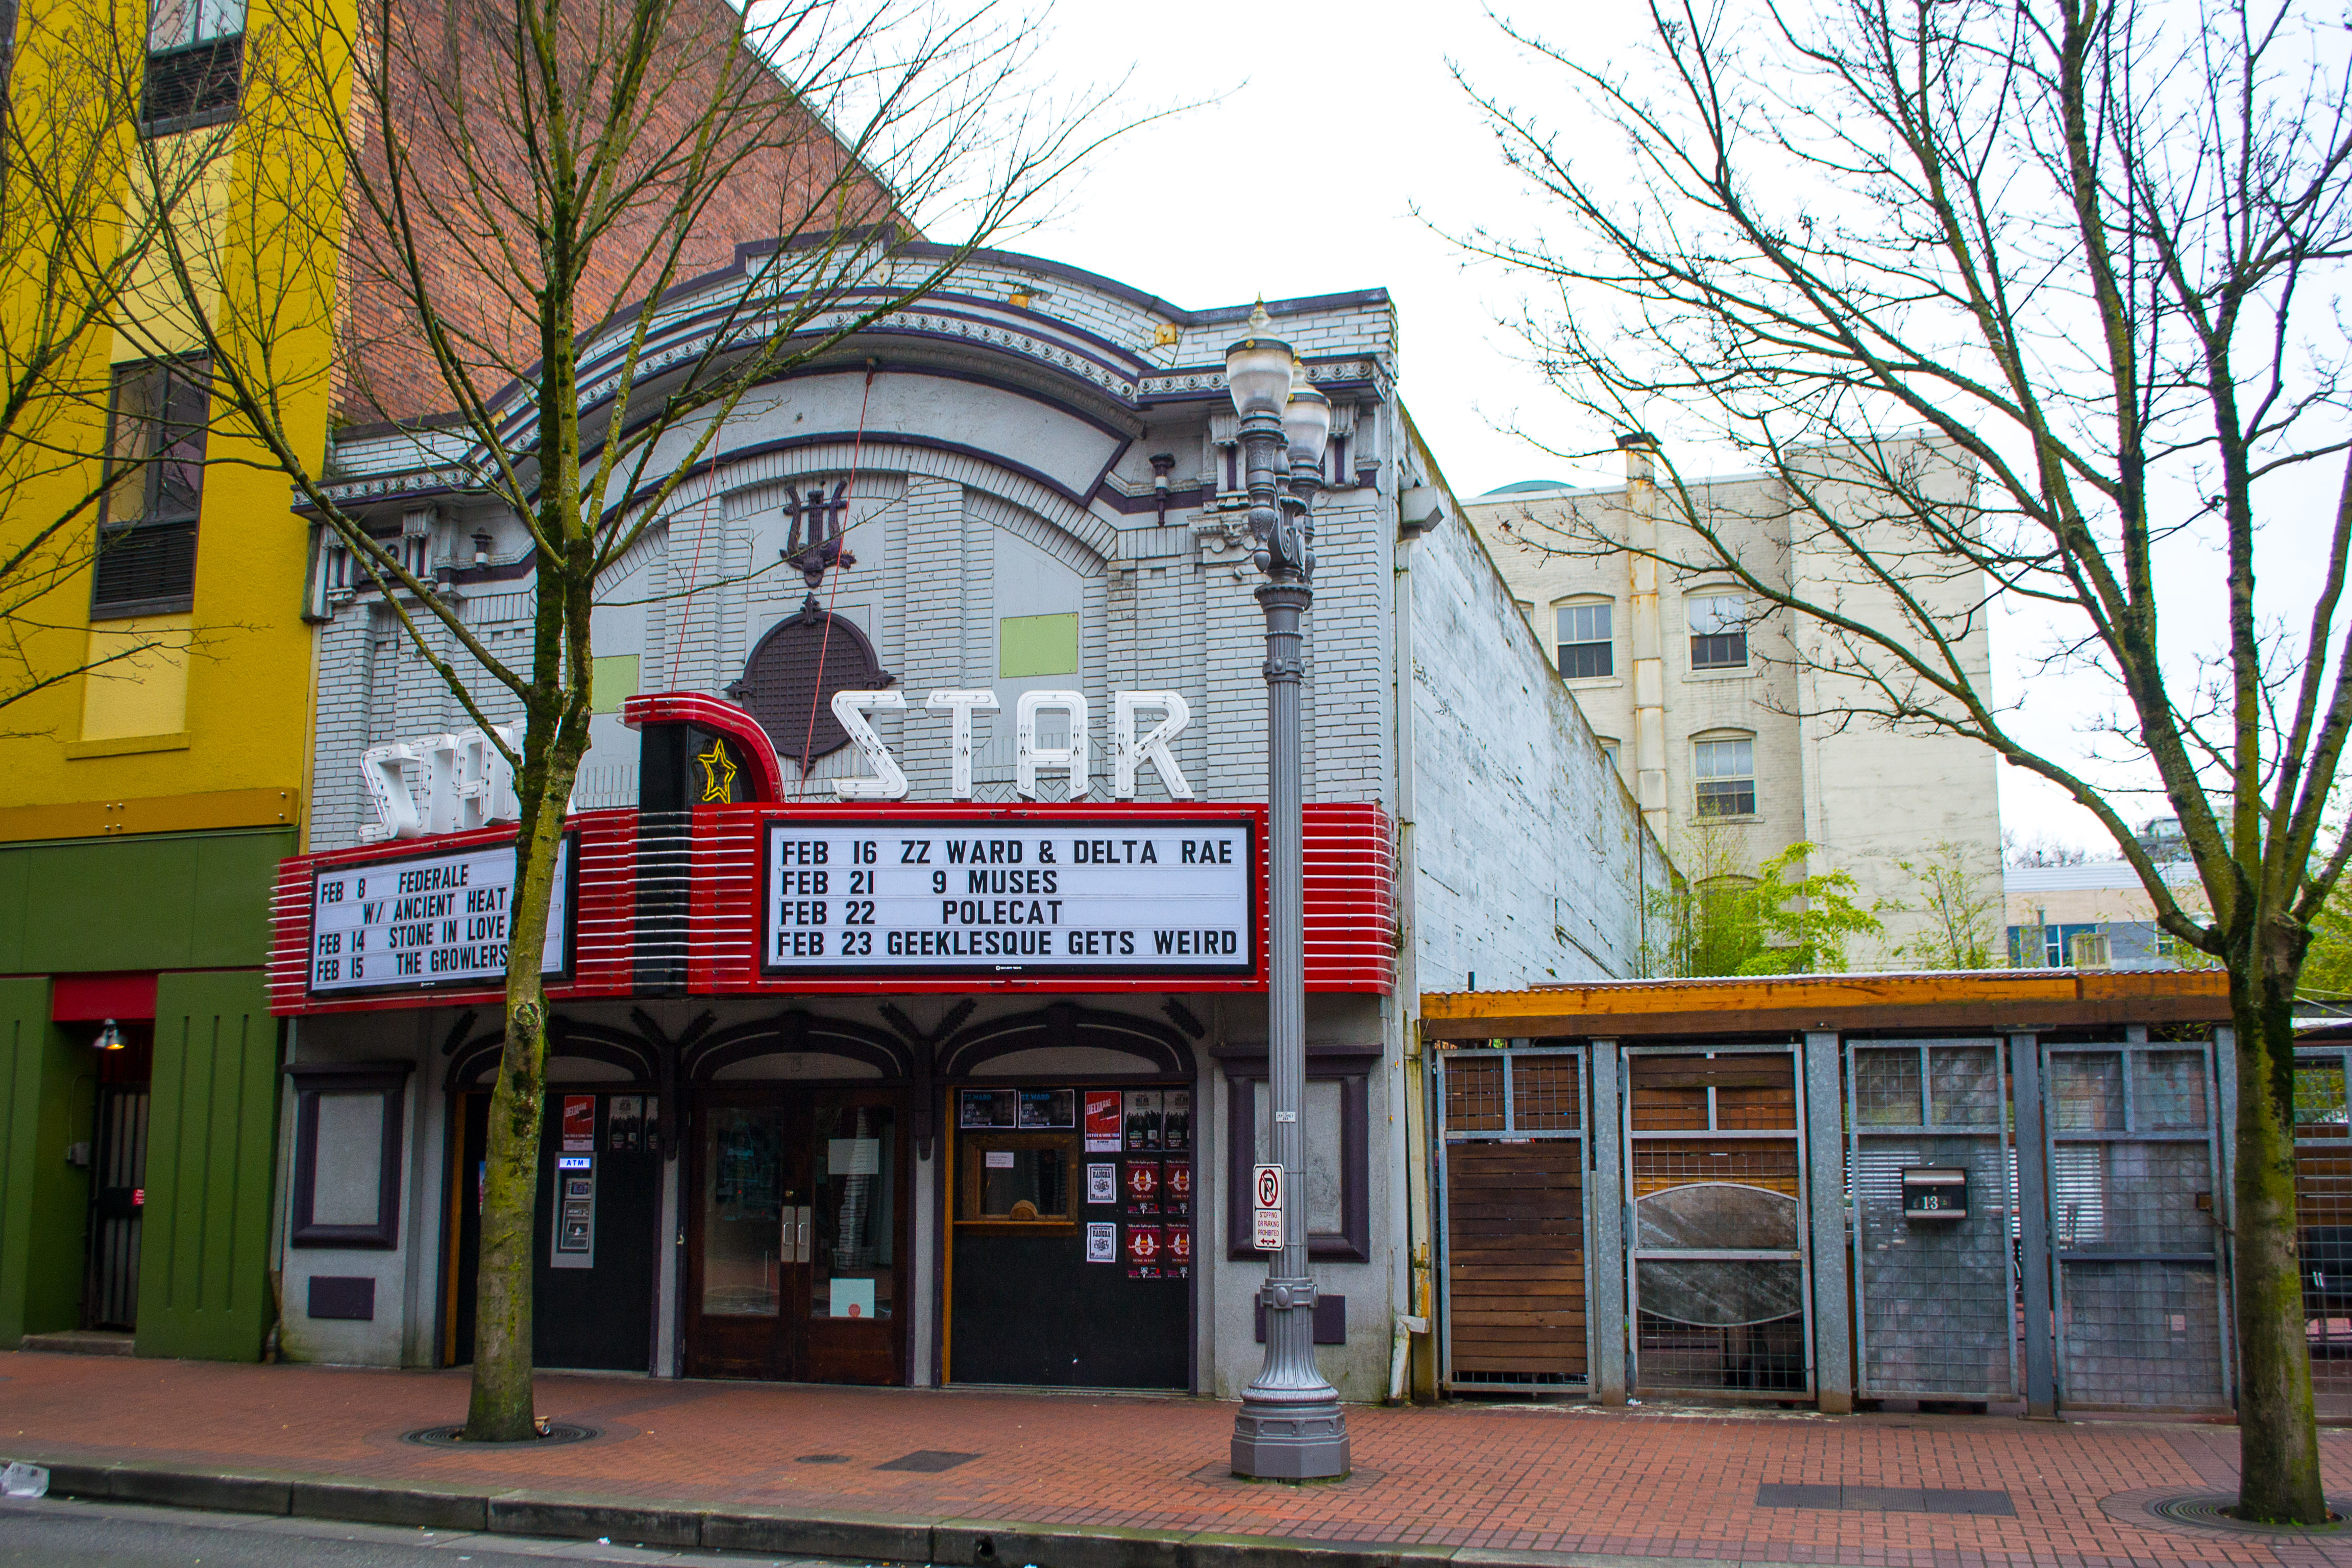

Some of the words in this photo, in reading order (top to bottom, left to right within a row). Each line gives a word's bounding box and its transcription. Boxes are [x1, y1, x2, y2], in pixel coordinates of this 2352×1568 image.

[830, 690, 1195, 801] STAR
[782, 841, 828, 865] FEB
[854, 841, 876, 864] 16
[901, 840, 930, 864] ZZ
[946, 840, 1022, 864] WARD
[1039, 841, 1056, 863] &
[1074, 840, 1157, 863] DELTA
[1182, 840, 1231, 863] RAE
[321, 881, 344, 903] FEB
[358, 878, 365, 898] 8
[399, 865, 469, 894] FEDERALE
[782, 871, 828, 895] FEB
[850, 871, 873, 894] 21
[933, 871, 946, 894] 9
[969, 870, 1057, 893] MUSES
[364, 902, 384, 924] W/
[394, 893, 455, 921] ANCIENT
[468, 887, 506, 913] HEAT
[781, 901, 826, 925] FEB
[846, 901, 874, 924] 22
[943, 900, 1062, 924] POLECAT
[318, 933, 340, 955] FEB
[352, 930, 364, 952] 14
[389, 923, 433, 948] STONE
[443, 920, 457, 943] IN
[468, 917, 504, 941] LOVE
[778, 932, 824, 956] FEB
[842, 932, 871, 955] 23
[888, 931, 1051, 955] GEEKLESQUE
[1069, 931, 1134, 954] GETS
[1154, 930, 1236, 954] WEIRD
[316, 961, 339, 982] FEB
[351, 958, 363, 979] 15
[396, 951, 421, 975] THE
[431, 944, 507, 973] GROWLERS
[1087, 1101, 1103, 1115] DELTA
[1102, 1099, 1111, 1108] RAE
